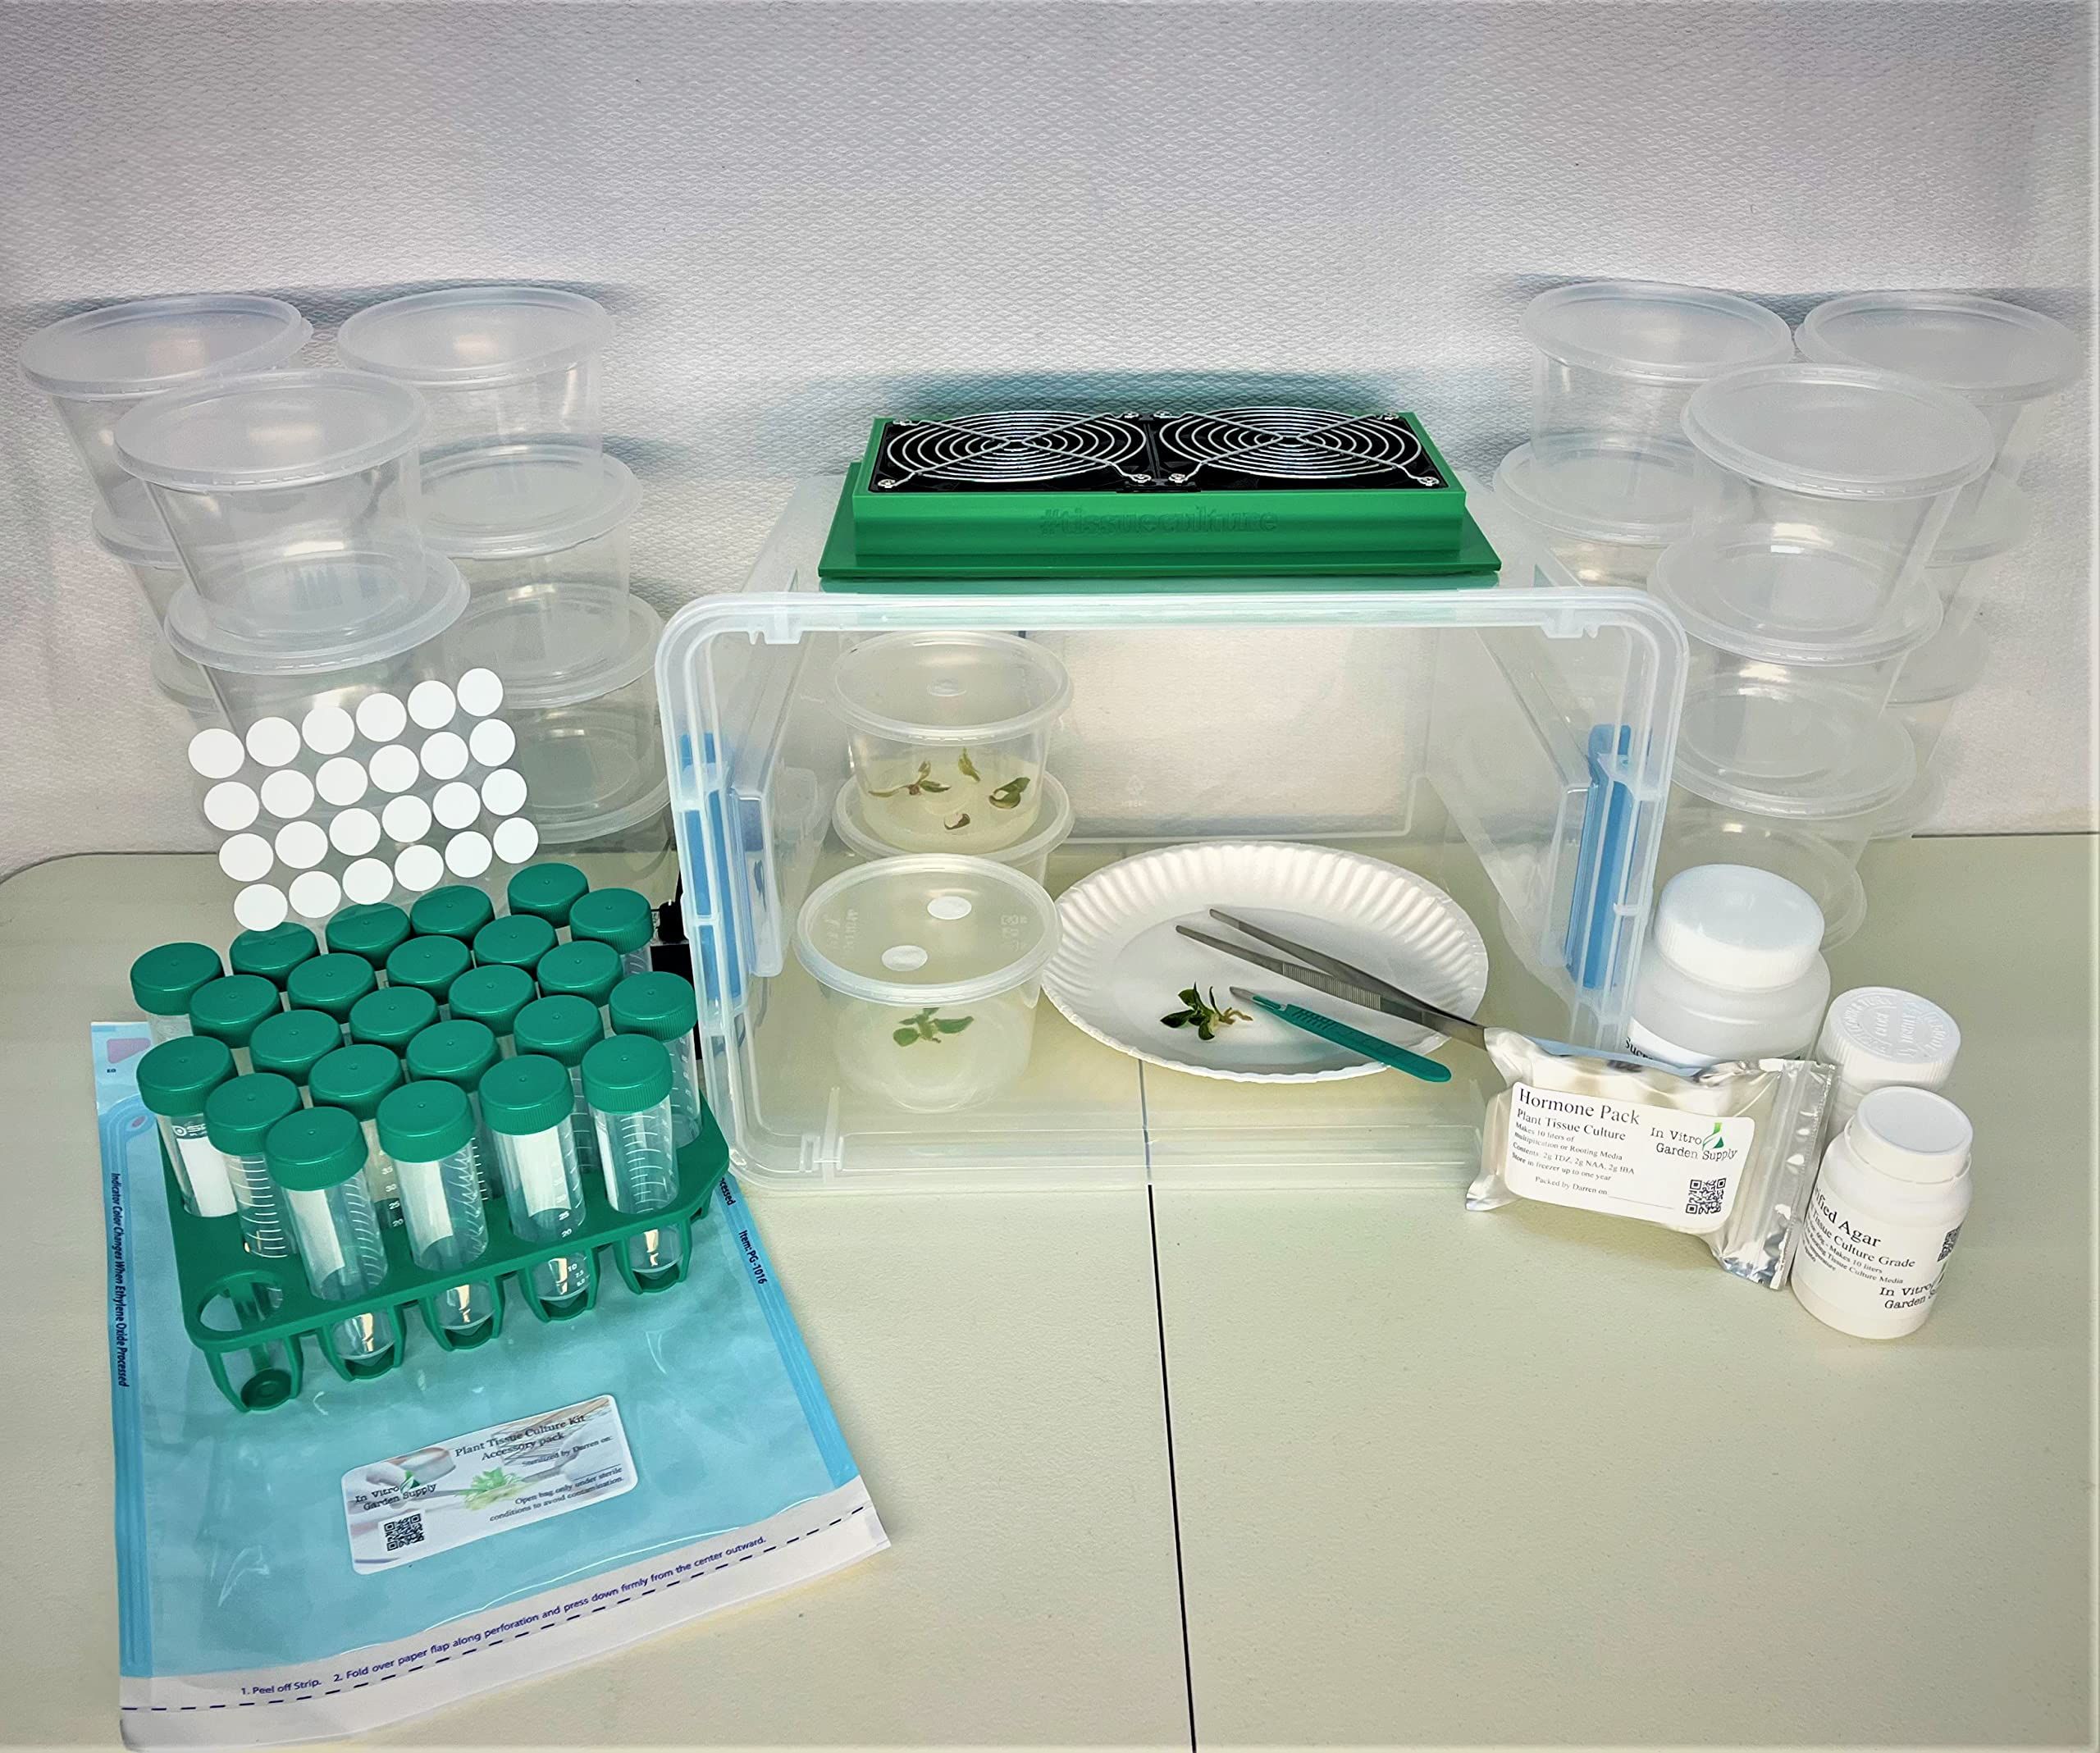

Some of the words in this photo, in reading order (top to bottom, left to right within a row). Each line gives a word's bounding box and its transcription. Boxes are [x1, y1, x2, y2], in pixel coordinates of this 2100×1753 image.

[1520, 1089, 1594, 1116] Hormone
[1600, 1105, 1640, 1125] Pack
[1516, 1122, 1535, 1134] Makes
[1547, 1132, 1564, 1140] liters
[1517, 1108, 1541, 1125] Plant
[1545, 1117, 1580, 1132] Tissue
[1583, 1125, 1626, 1140] Culture
[1650, 1127, 1664, 1138] In
[1670, 1130, 1702, 1145] Vitro
[1570, 1145, 1597, 1157] Rooting
[1600, 1151, 1623, 1160] Media
[1574, 1158, 1583, 1166] 2g
[1609, 1164, 1617, 1172] 2g
[1656, 1143, 1698, 1159] Garden
[1702, 1148, 1737, 1162] Supply
[1512, 1152, 1526, 1163] Store
[1536, 1162, 1560, 1171] freezer
[1596, 1173, 1611, 1181] year
[112, 1173, 121, 1205] Indicator
[386, 1184, 397, 1192] 30
[1535, 1176, 1560, 1187] Packed
[1562, 1181, 1570, 1189] by
[1573, 1184, 1596, 1193] Darren
[112, 1206, 123, 1226] Color
[389, 1201, 400, 1209] 25
[559, 1211, 569, 1221] 25
[392, 1218, 404, 1226] 20
[561, 1228, 572, 1238] 20
[1838, 1221, 1881, 1247] Agar
[112, 1227, 124, 1259] Changes
[1834, 1235, 1875, 1262] Culture
[1879, 1256, 1915, 1267] Grade
[739, 1230, 751, 1251] Item:
[746, 1250, 767, 1284] PG-1016
[1828, 1252, 1847, 1269] Tissue
[1849, 1267, 1877, 1280] Culture
[1829, 1245, 1851, 1262] Makes
[1864, 1264, 1883, 1273] liters
[115, 1261, 125, 1284] When
[1879, 1287, 1894, 1296] In
[1902, 1283, 1932, 1295] Vitro
[1884, 1295, 1926, 1308] Garden
[113, 1285, 126, 1322] Ethylene
[116, 1323, 127, 1345] Oxide
[116, 1346, 130, 1387] Processed
[455, 1442, 486, 1457] Plant
[486, 1433, 522, 1448] Tissue
[525, 1420, 566, 1437] Culture
[568, 1414, 586, 1426] Kit
[482, 1441, 536, 1461] Accessory
[540, 1431, 565, 1445] pack
[522, 1452, 559, 1466] Sterilized
[573, 1441, 599, 1454] Darren
[363, 1495, 399, 1510] Garden
[403, 1484, 436, 1499] Supply
[372, 1486, 399, 1497] Vitro
[515, 1495, 537, 1504] Open
[539, 1490, 554, 1499] bag
[555, 1484, 573, 1493] only
[575, 1477, 596, 1487] under
[599, 1468, 622, 1479] sterile
[490, 1505, 532, 1522] conditions
[543, 1495, 566, 1506] avoid
[253, 1686, 275, 1694] Peel
[277, 1683, 292, 1692] off
[294, 1680, 322, 1691] Strip.
[346, 1667, 369, 1678] Fold
[372, 1660, 395, 1673] over
[398, 1650, 427, 1666] paper
[431, 1642, 450, 1654] flap
[453, 1633, 482, 1647] along
[484, 1614, 539, 1639] perforation
[542, 1605, 561, 1618] and
[564, 1598, 589, 1613] press
[591, 1589, 619, 1602] down
[621, 1577, 648, 1592] firmly
[651, 1569, 673, 1582] from
[675, 1563, 692, 1573] the
[694, 1551, 723, 1566] center
[725, 1536, 766, 1556] outward.
